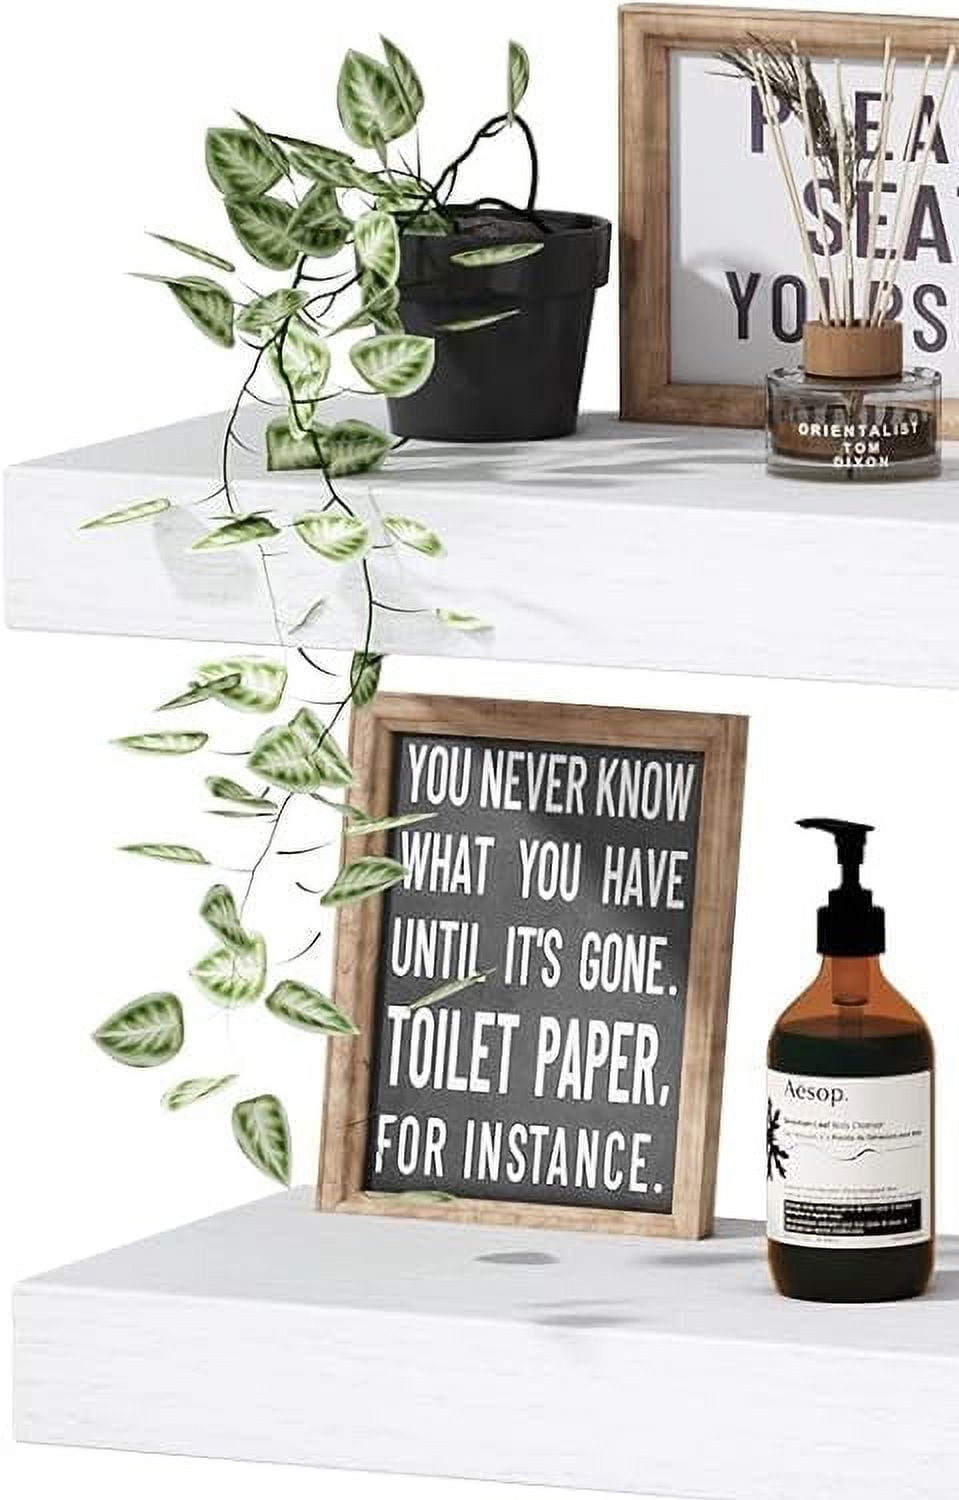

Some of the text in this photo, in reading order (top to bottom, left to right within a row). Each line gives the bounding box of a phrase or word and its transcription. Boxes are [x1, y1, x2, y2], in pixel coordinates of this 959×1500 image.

[798, 421, 918, 437] ORIENTALIST
[833, 455, 889, 467] DIXON
[842, 441, 880, 454] TOM
[408, 743, 696, 822] YOU NEVER KNOW
[401, 831, 689, 909] WHAT YOU HAVE
[391, 916, 678, 996] UNTIL IT'S GONE.
[387, 1003, 669, 1107] TOILET PAPER,
[784, 1079, 849, 1107] Aesop.
[374, 1113, 662, 1194] FOR INSTANCE.
